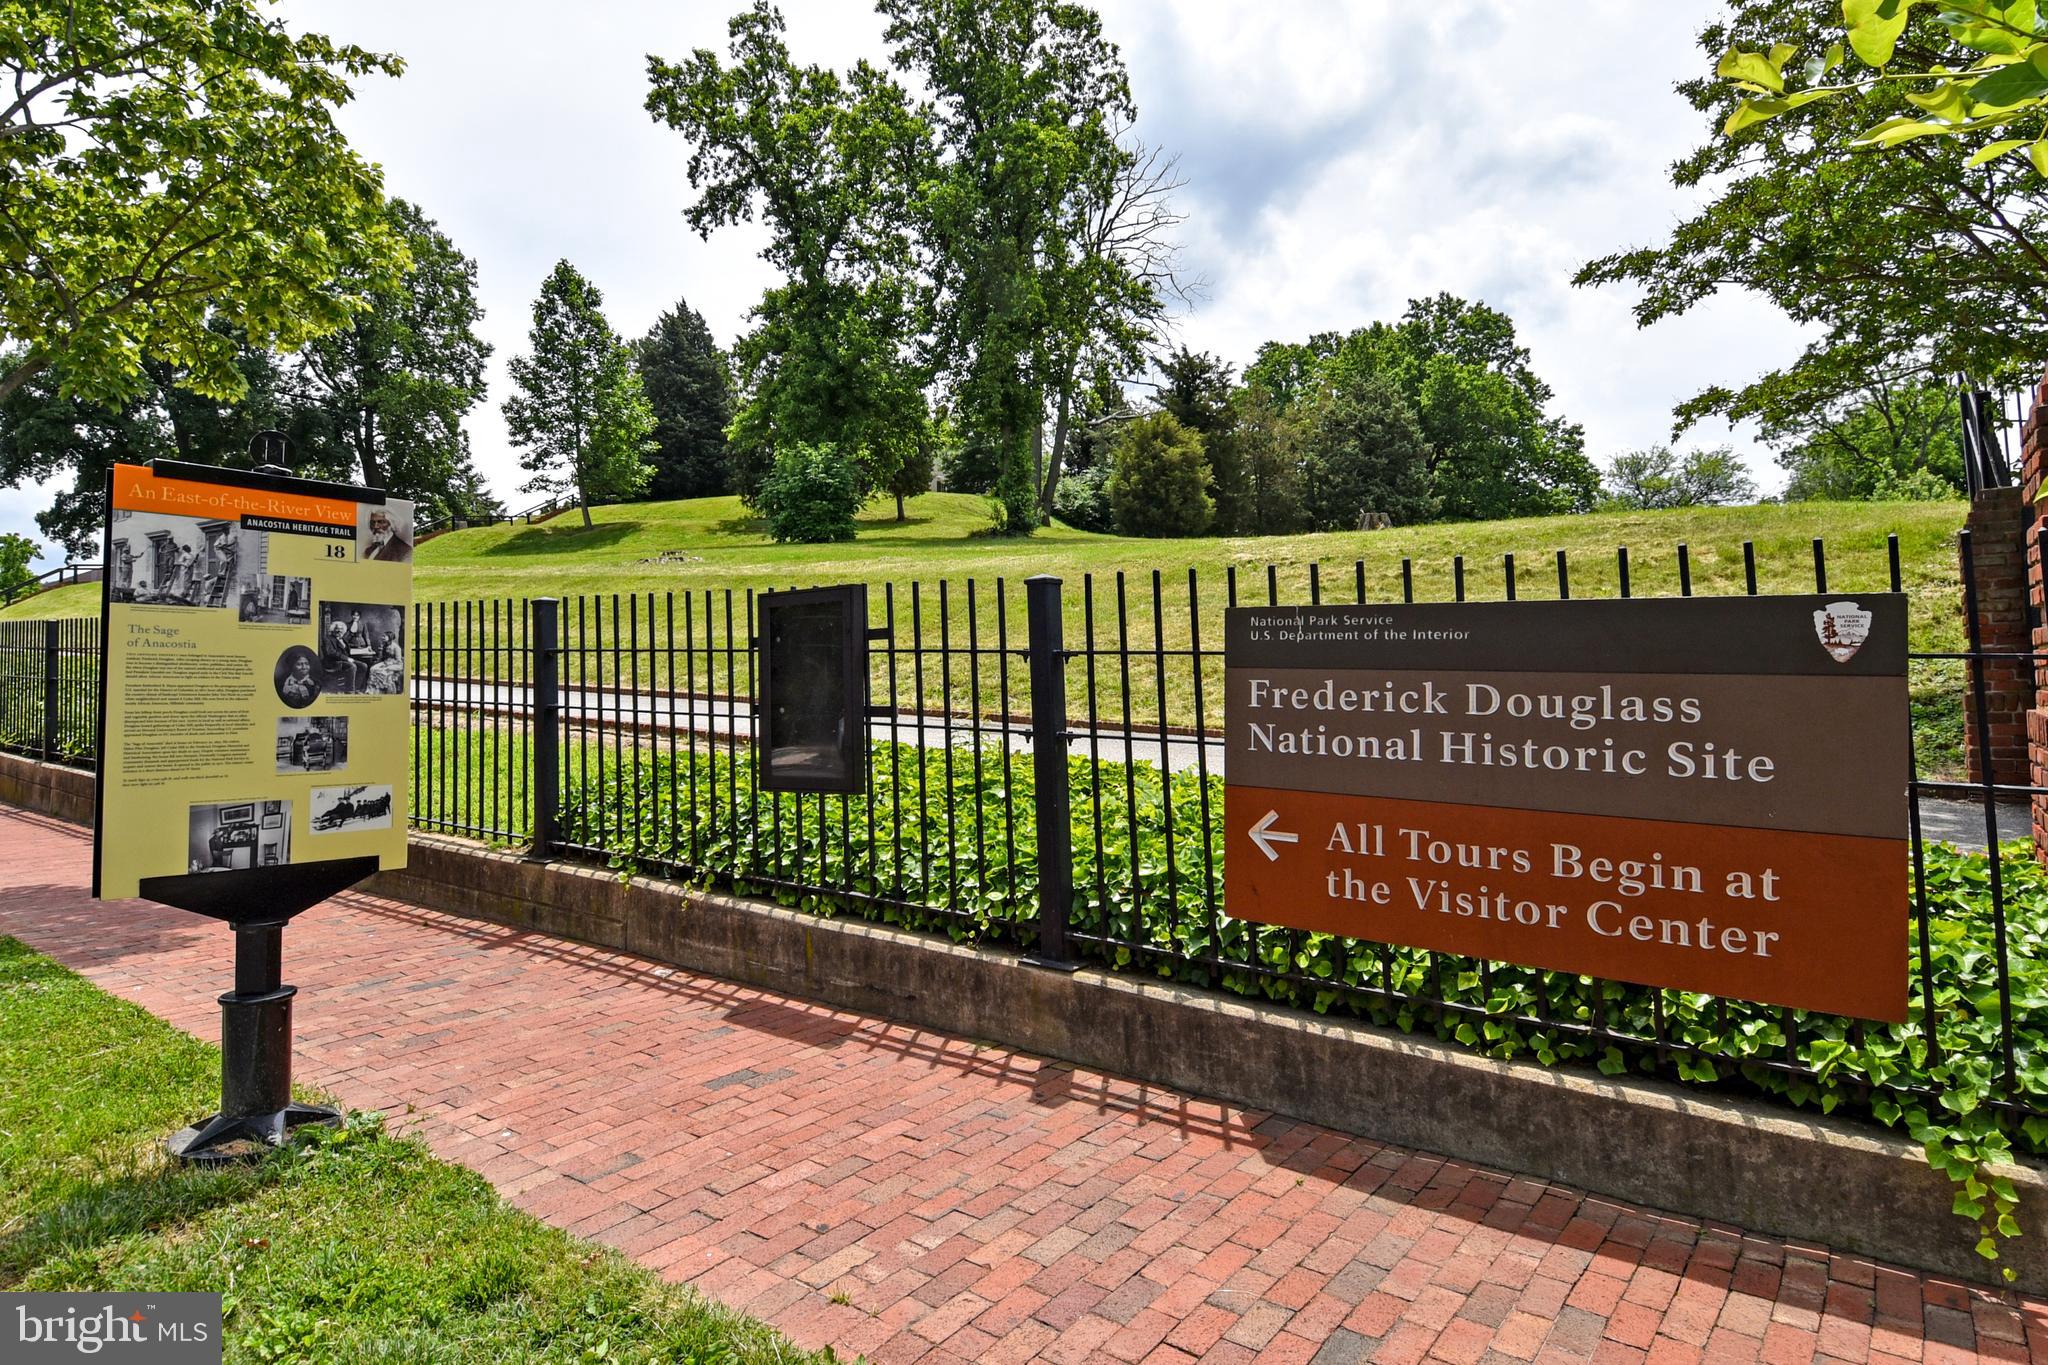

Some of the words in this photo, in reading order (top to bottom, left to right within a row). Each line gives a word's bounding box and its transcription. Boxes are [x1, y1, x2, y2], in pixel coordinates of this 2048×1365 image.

[128, 483, 156, 500] An
[161, 486, 311, 517] East-of-the-River
[315, 504, 353, 521] View
[247, 518, 291, 530] ANACOSTIA
[292, 523, 329, 534] HERITAGE
[331, 527, 352, 537] TRAIL
[325, 544, 346, 559] 18
[1250, 616, 1304, 627] National
[1309, 615, 1338, 627] Park
[1343, 615, 1394, 626] Service
[128, 624, 151, 634] The
[153, 625, 180, 638] Sage
[1250, 630, 1275, 641] U.S.
[1279, 630, 1359, 643] Department
[1364, 629, 1379, 641] of
[1384, 630, 1408, 641] the
[1413, 629, 1470, 641] Interior
[127, 637, 141, 647] of
[142, 638, 197, 649] Anacostia
[1248, 678, 1448, 714] Frederick
[1466, 683, 1702, 731] Douglass
[1247, 722, 1423, 763] National
[1439, 730, 1647, 775] Historic
[1667, 741, 1776, 783] Site
[1326, 821, 1385, 857] All
[1399, 828, 1532, 874] Tours
[1550, 843, 1702, 897] Begin
[1725, 867, 1781, 902] at
[1326, 868, 1391, 904] the
[1406, 876, 1568, 929] Visitor
[1587, 900, 1780, 958] Center
